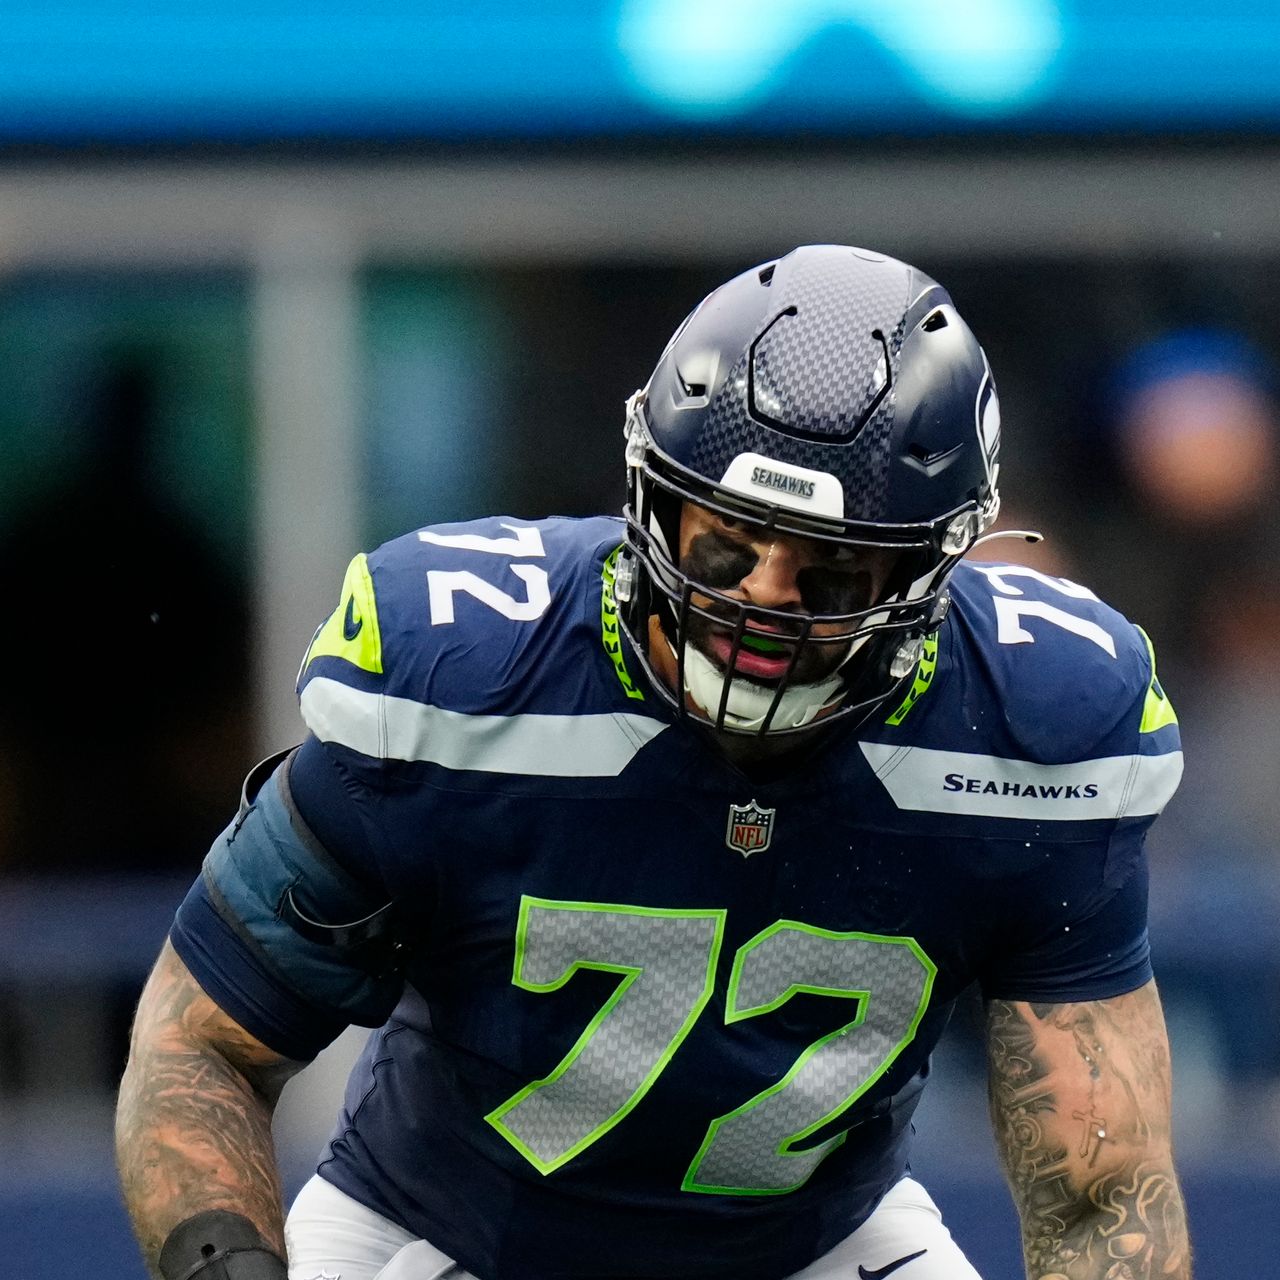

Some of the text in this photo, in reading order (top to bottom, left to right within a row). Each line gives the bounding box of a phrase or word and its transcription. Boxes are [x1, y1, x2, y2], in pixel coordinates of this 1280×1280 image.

[750, 466, 816, 498] SEAHAWKS
[418, 523, 552, 626] 72
[733, 825, 764, 849] NFL
[484, 894, 938, 1195] 72
